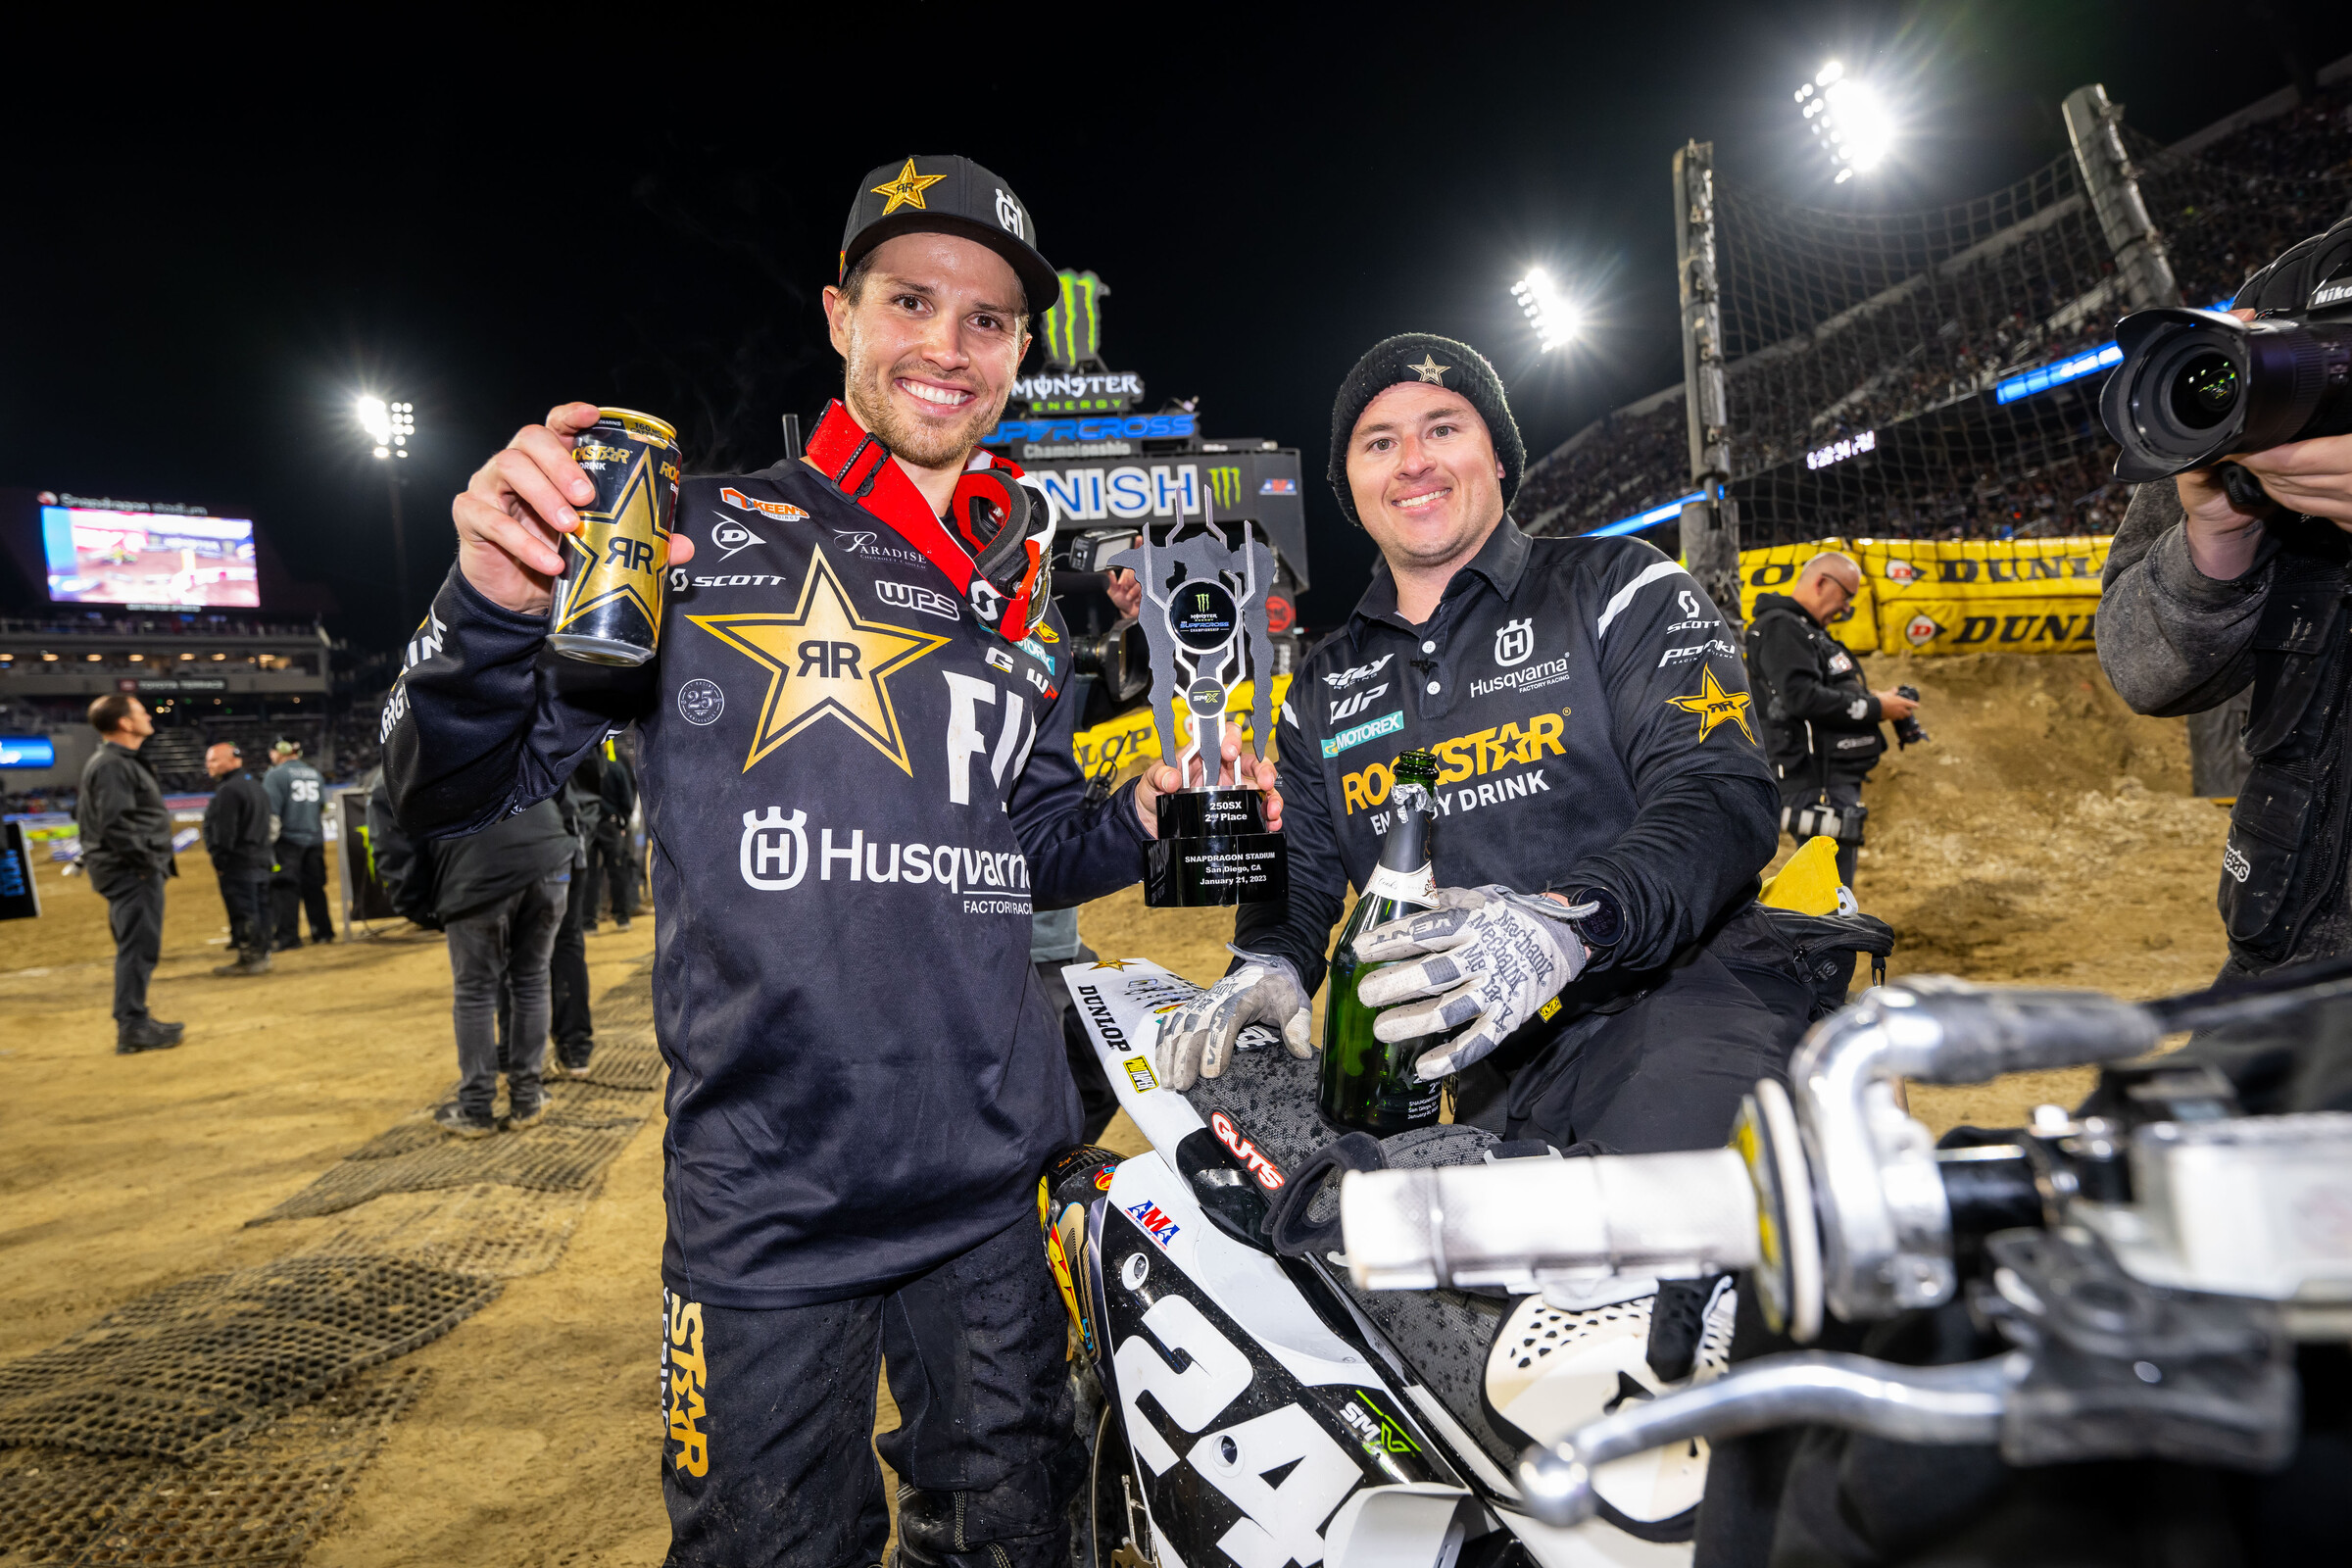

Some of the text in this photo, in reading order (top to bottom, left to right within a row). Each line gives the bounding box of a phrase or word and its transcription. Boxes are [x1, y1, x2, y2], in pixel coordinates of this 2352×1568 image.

[1010, 373, 1142, 400] MONSTER
[1032, 399, 1123, 412] ENERGY
[634, 421, 651, 431] 160
[982, 414, 1196, 444] UPERCROSS
[572, 444, 630, 465] CKSTAR
[1023, 441, 1131, 460] Championship
[1041, 464, 1200, 521] NISH
[752, 499, 809, 518] KEEN'S
[760, 510, 799, 520] BUILDINGS
[692, 574, 786, 588] SCOTT
[875, 580, 960, 621] WPS
[1667, 620, 1721, 634] SCOTT
[1333, 672, 1378, 689] RACING
[1470, 657, 1568, 698] Husqvarna
[1519, 674, 1570, 694] FACTORY RACING
[687, 690, 713, 710] 25
[1193, 693, 1218, 704] SMX
[1330, 682, 1390, 725] WP
[1336, 712, 1400, 750] MOTOREX
[1082, 725, 1152, 768] LOP
[291, 780, 319, 803] 35
[1458, 769, 1550, 812] DRINK
[1209, 801, 1243, 811] 250SX
[1221, 812, 1248, 821] Place
[820, 828, 1031, 895] Husqvarn
[1185, 852, 1276, 863] SNAPDRAGON STADIUM
[1224, 865, 1250, 874] Diego,
[1078, 985, 1132, 1053] DUNLOP
[1212, 1111, 1285, 1190] GUTS
[1127, 1200, 1180, 1247] AMA
[670, 1292, 709, 1478] STAR
